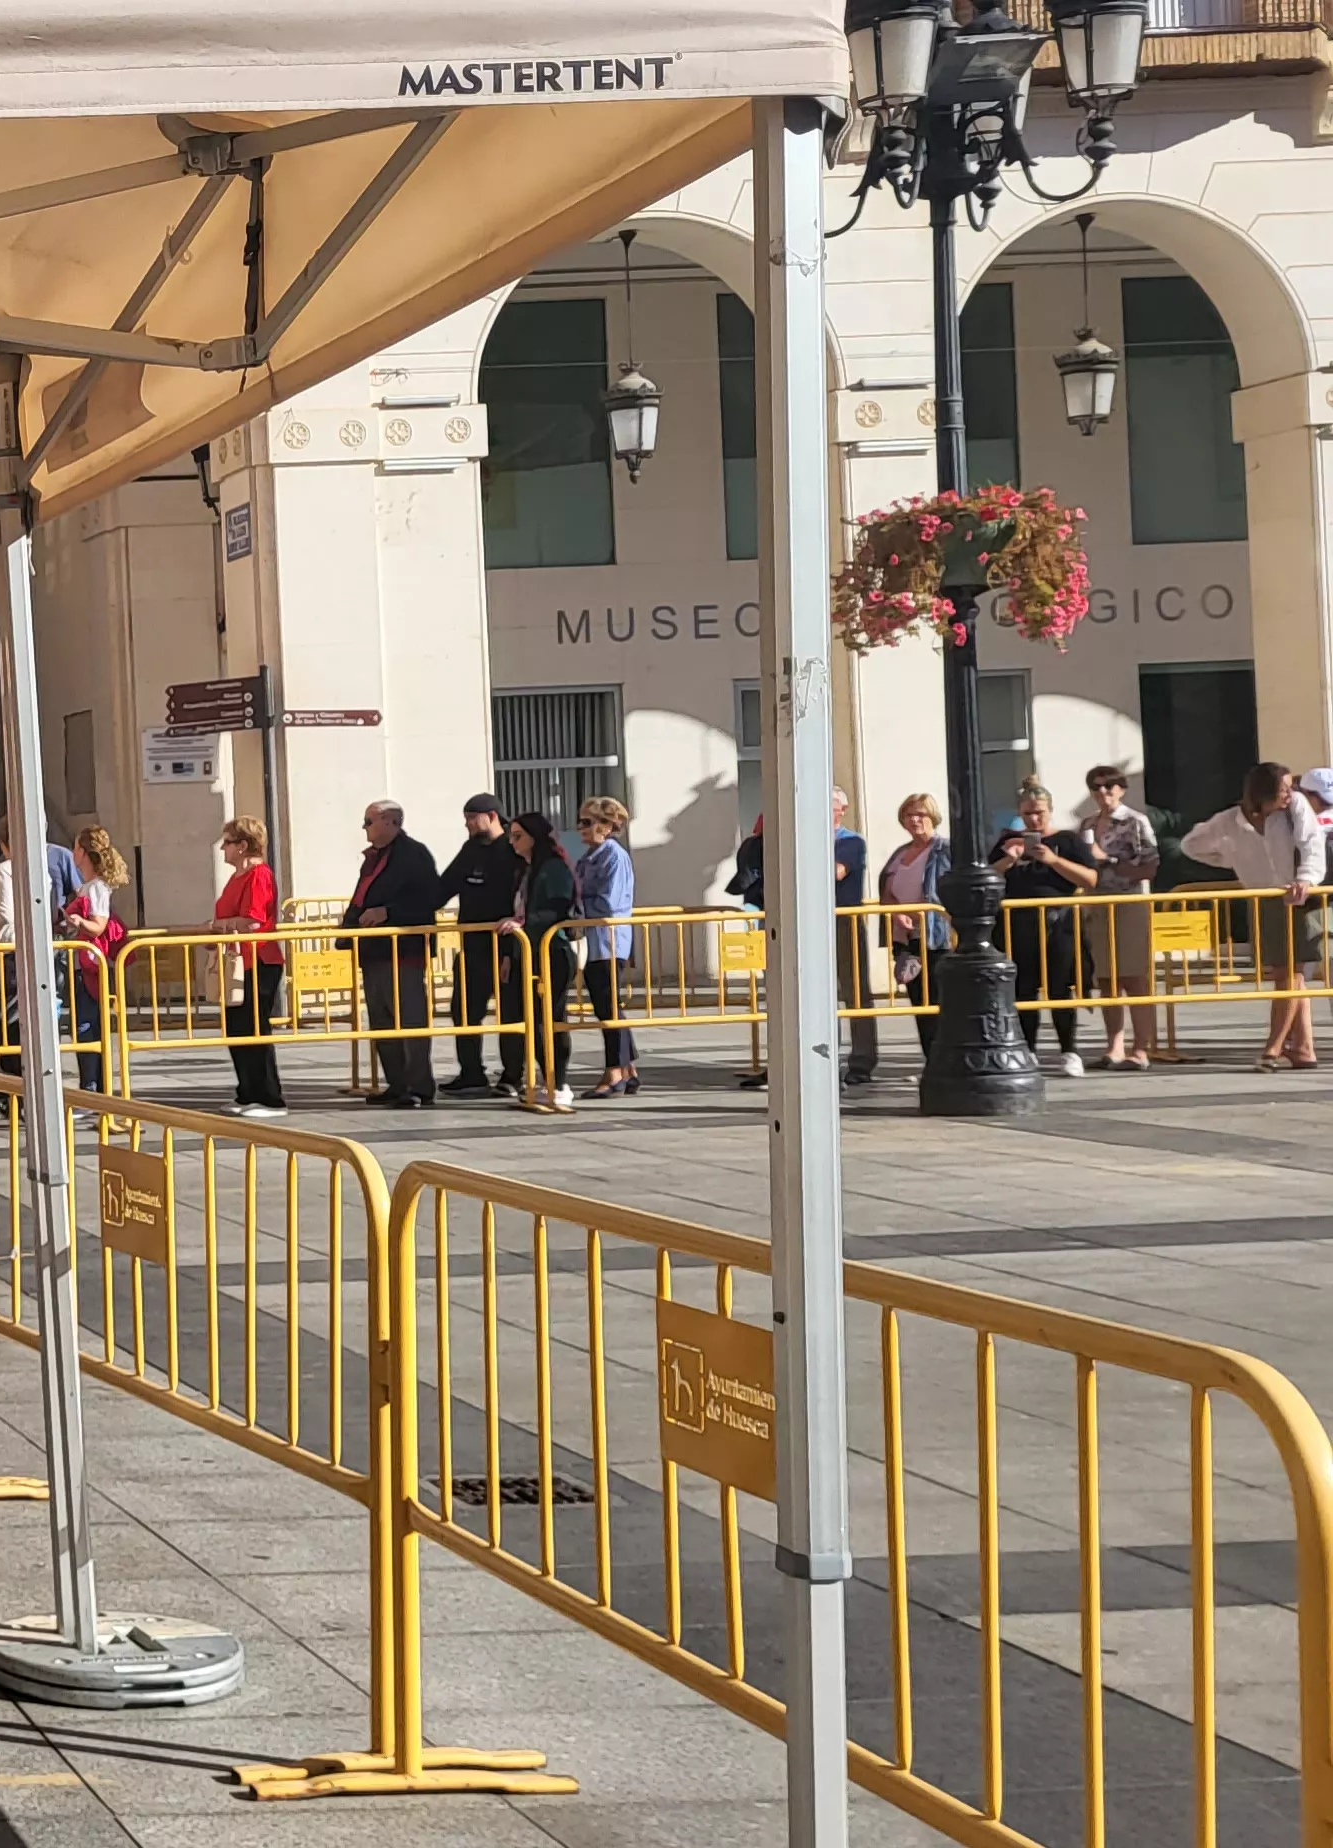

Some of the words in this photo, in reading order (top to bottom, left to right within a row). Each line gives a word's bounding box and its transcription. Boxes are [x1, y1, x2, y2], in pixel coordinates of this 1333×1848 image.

[398, 56, 674, 96] MASTERTENT
[556, 602, 761, 645] MUSEO
[706, 1368, 776, 1411] Ayuntamien
[706, 1398, 721, 1421] de
[723, 1402, 769, 1440] Huesca
